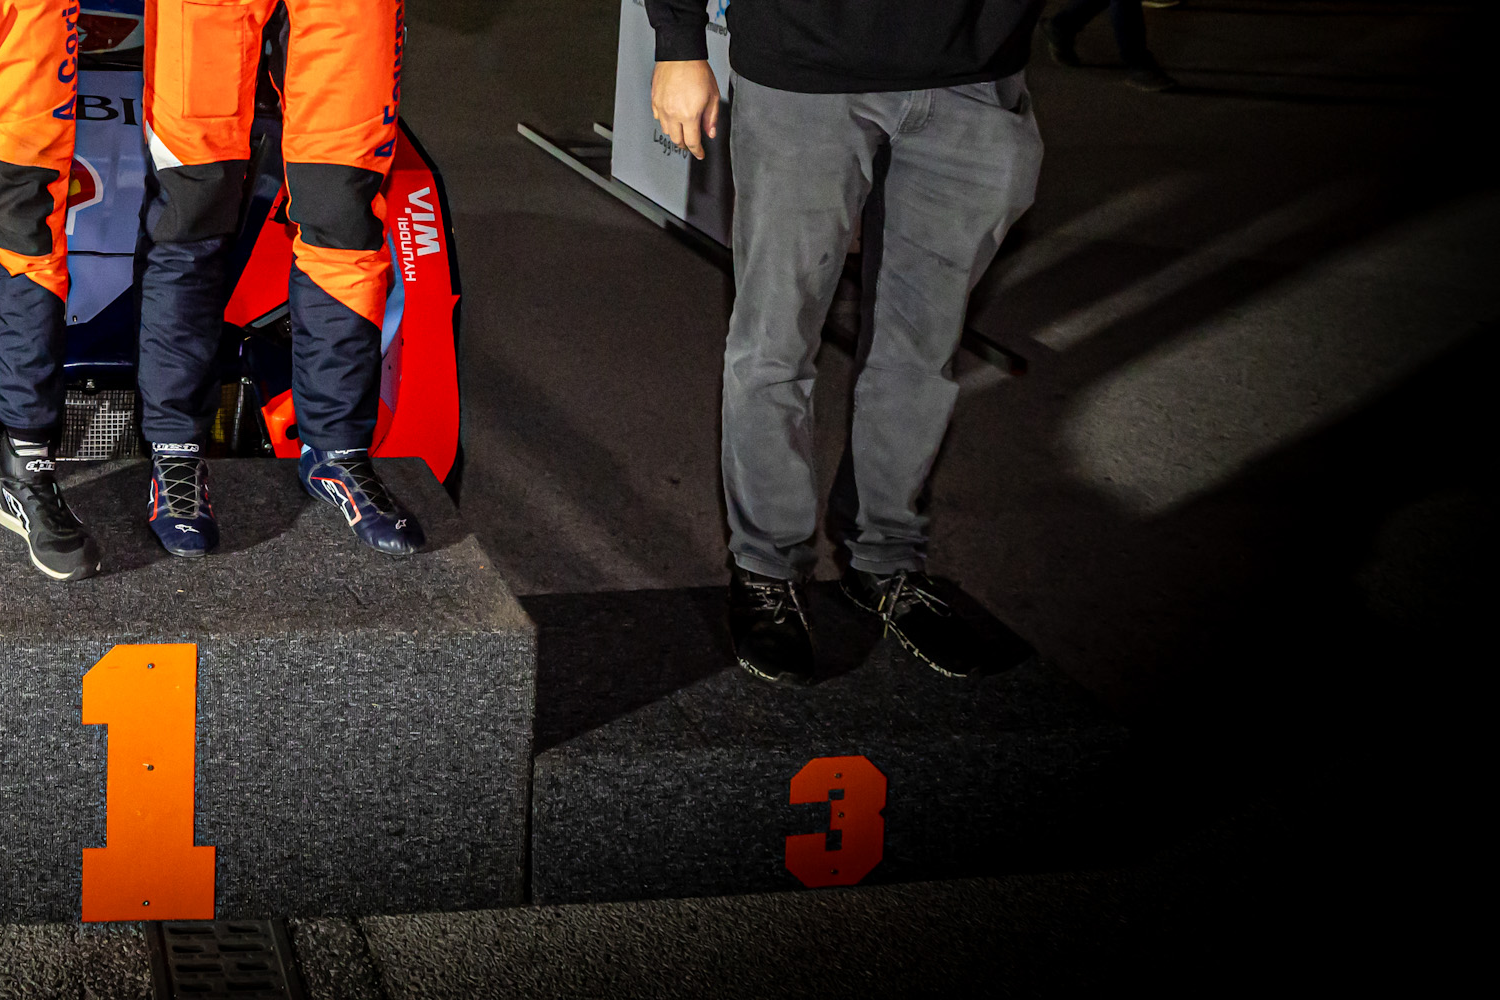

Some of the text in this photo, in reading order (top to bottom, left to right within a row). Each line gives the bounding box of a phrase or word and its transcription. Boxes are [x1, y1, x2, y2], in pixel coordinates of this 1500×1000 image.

[397, 217, 416, 281] HYUNDAI
[82, 643, 216, 922] 1
[785, 755, 887, 888] 3
